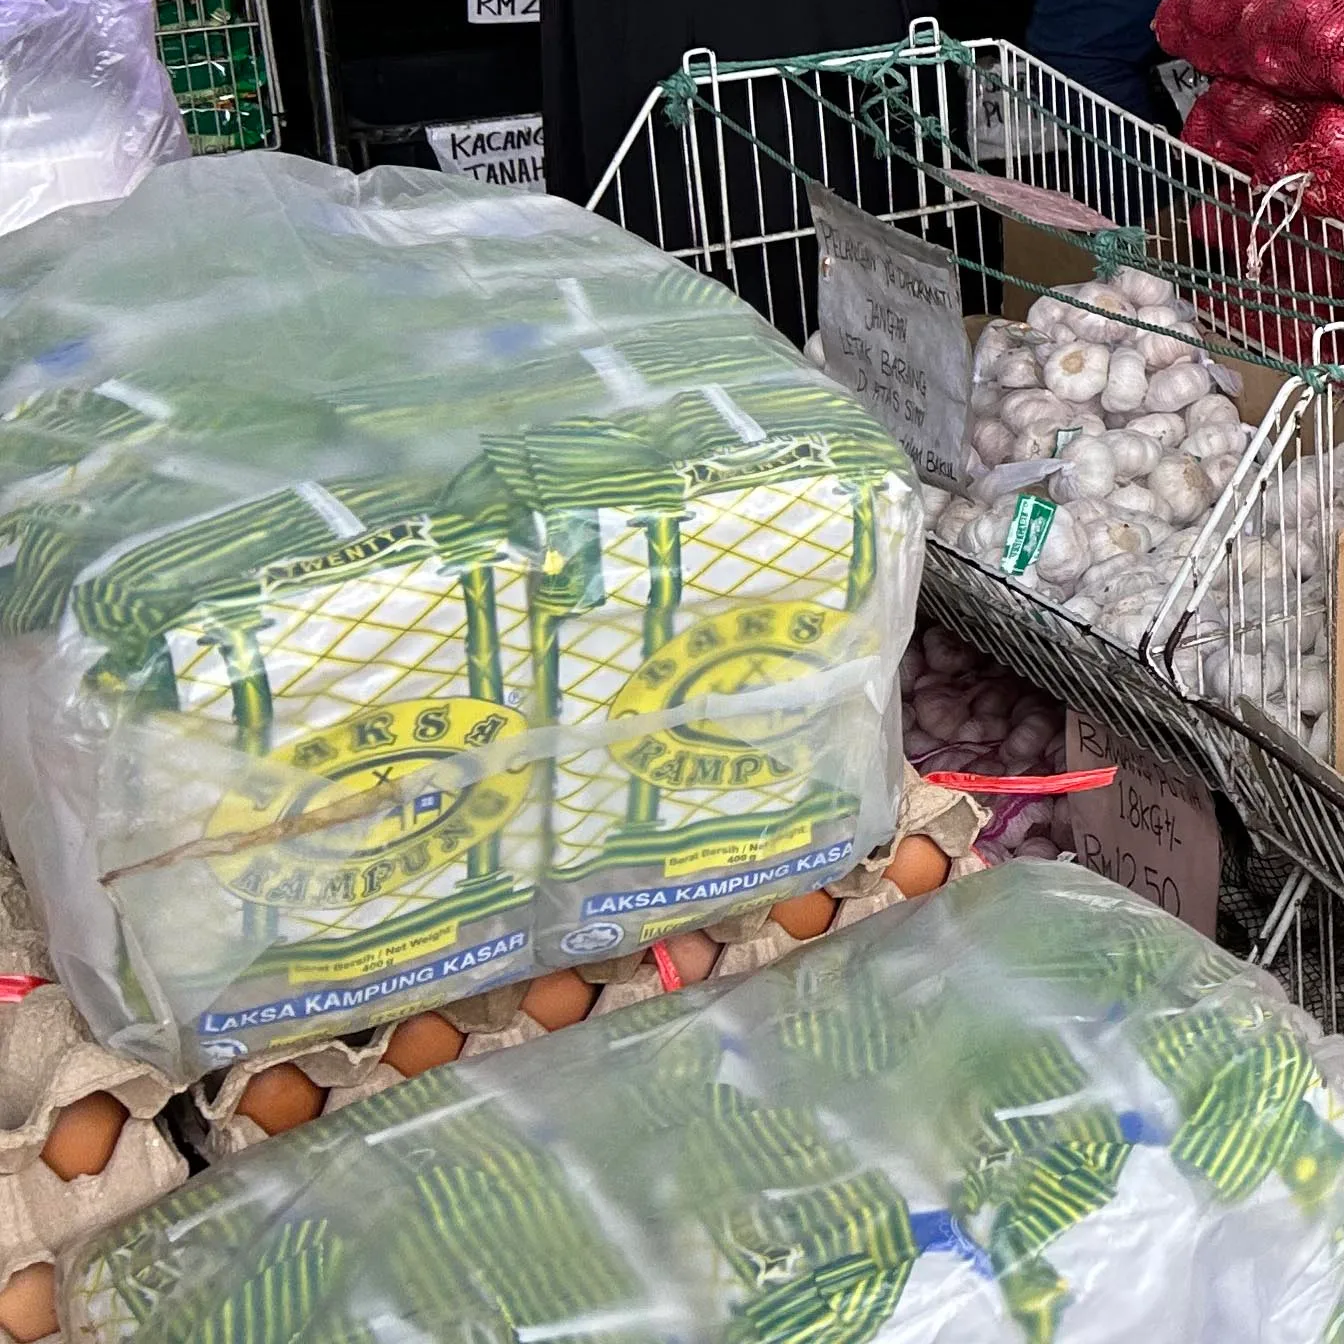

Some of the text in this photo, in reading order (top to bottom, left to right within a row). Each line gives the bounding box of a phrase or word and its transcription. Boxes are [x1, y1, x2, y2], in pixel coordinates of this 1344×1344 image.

[452, 125, 545, 161] KACANG
[864, 299, 907, 344] JANGAN
[881, 351, 927, 398] BARANG
[926, 451, 957, 481] BAKUL
[586, 891, 668, 916] LAKSA
[675, 864, 790, 903] KAMPUNG
[385, 942, 406, 957] Net
[204, 931, 527, 1033] LAKSA KAMPUNG KASAR
